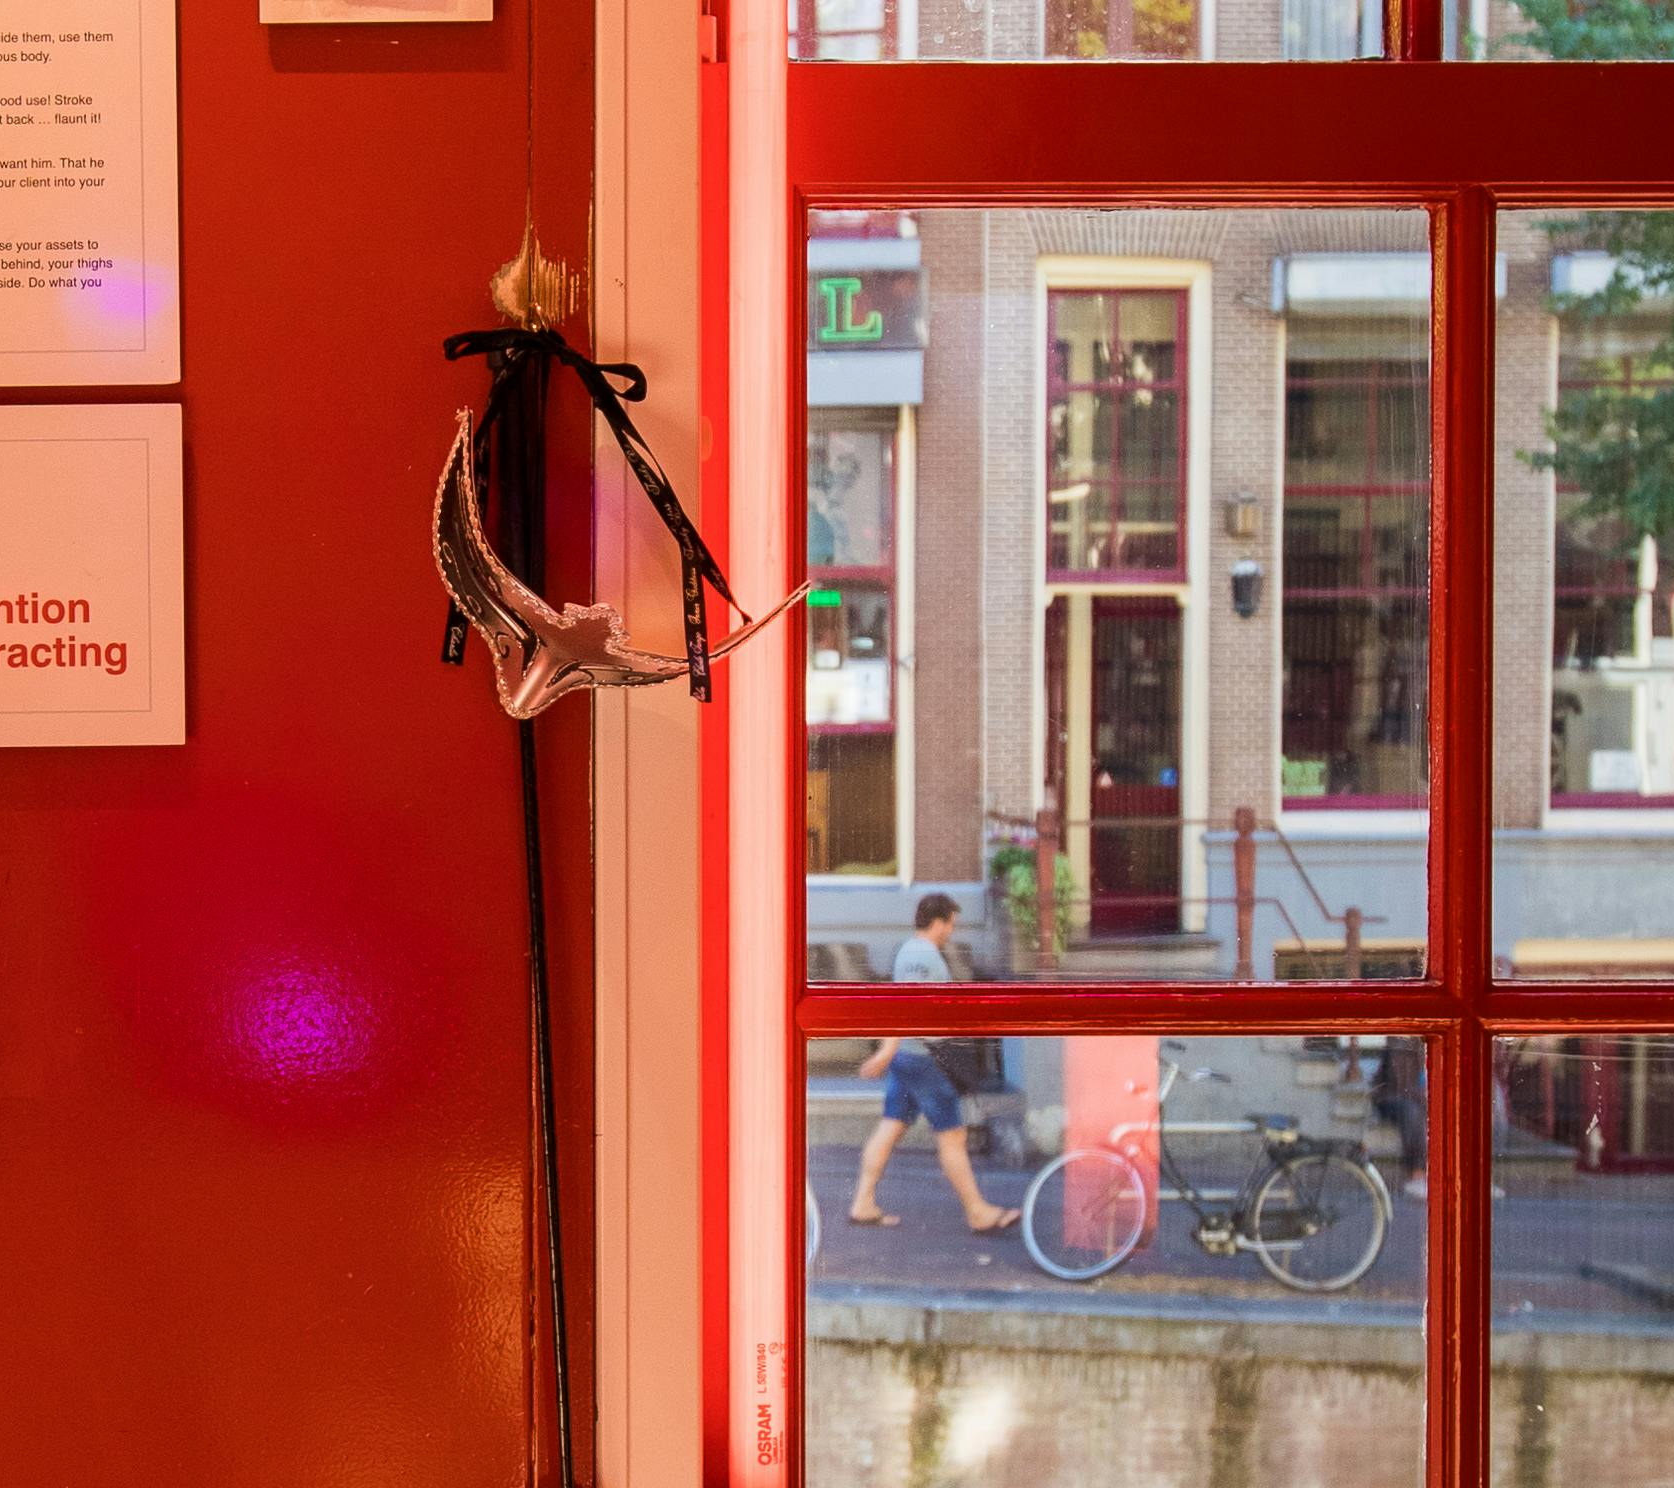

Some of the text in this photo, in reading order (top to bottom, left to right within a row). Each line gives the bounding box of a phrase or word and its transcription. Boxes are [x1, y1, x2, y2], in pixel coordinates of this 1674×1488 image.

[21, 31, 55, 44] them,
[58, 33, 81, 43] use
[83, 31, 114, 43] them
[20, 50, 52, 65] body.
[756, 1404, 772, 1466] OSRAM
